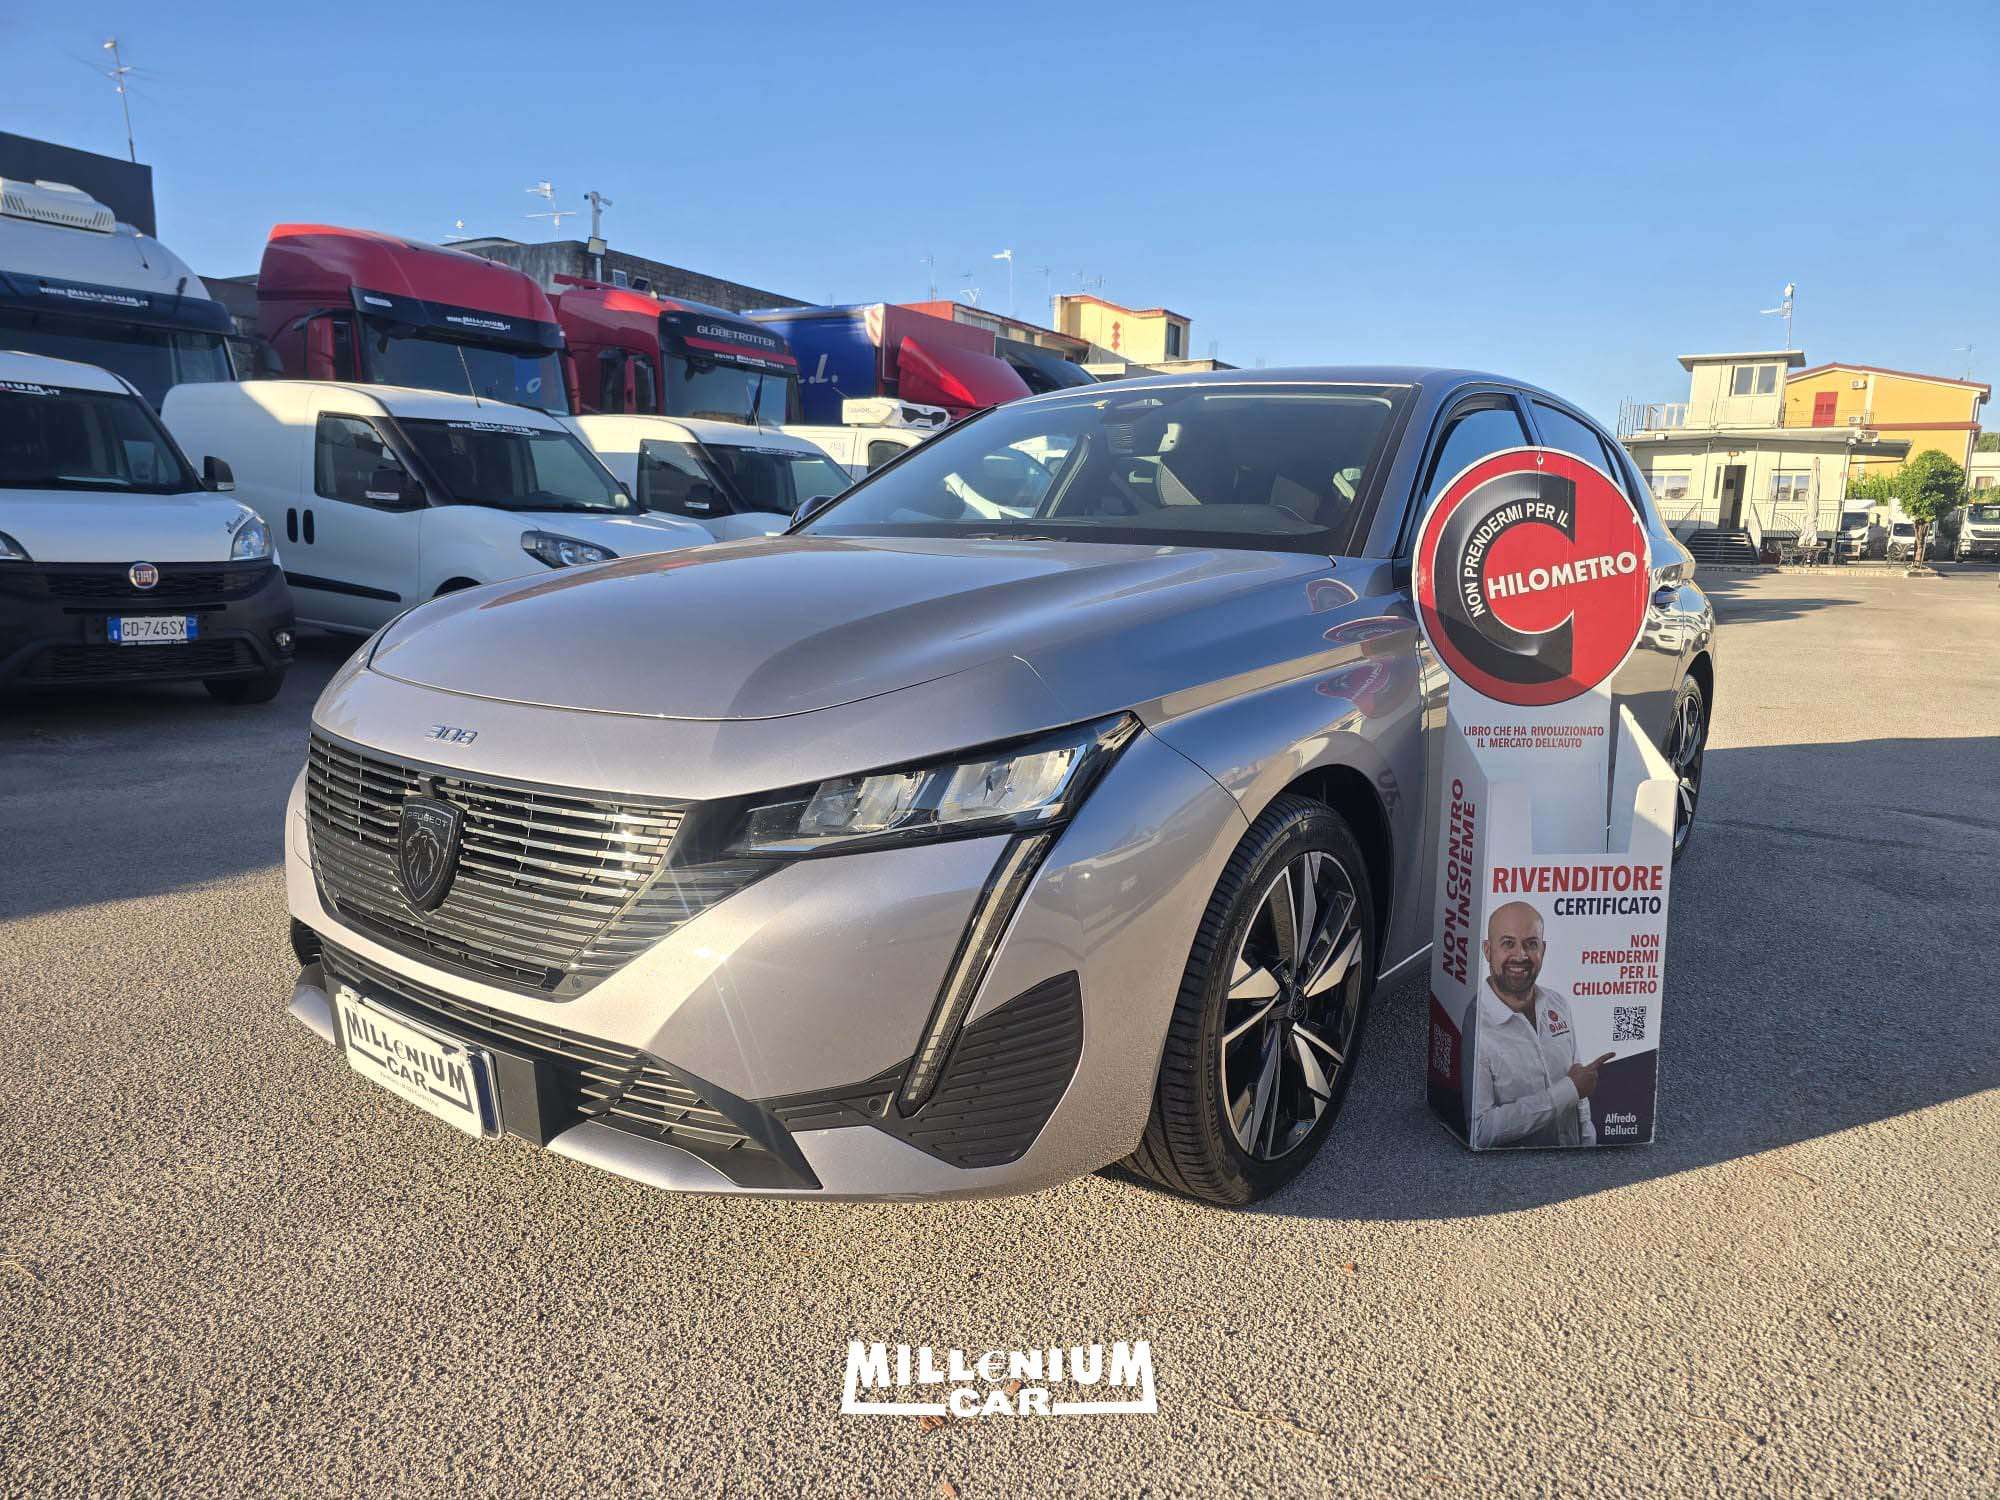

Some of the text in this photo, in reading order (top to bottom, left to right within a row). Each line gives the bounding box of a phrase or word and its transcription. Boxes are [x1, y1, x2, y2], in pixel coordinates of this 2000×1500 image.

[696, 325, 776, 348] GLOBETROTTER
[1464, 502, 1569, 618] NON PRENDERMI PER IL
[135, 570, 153, 583] FIAT
[425, 725, 478, 745] 308
[1463, 726, 1604, 736] LIBRO CHE HA RIVOLUZIONATO
[1477, 738, 1582, 748] IL MERCATO DELL'AUTO
[407, 811, 448, 827] PEUGEOT
[1442, 778, 1463, 976] NON CONTRO
[1492, 866, 1664, 893] RIVENDITORE
[1455, 801, 1475, 985] MA INSIEME
[1553, 896, 1662, 916] CERTIFICATO
[1630, 934, 1659, 948] NON
[1581, 950, 1659, 964] PRENDERMI
[1619, 965, 1659, 979] PER IL
[1572, 980, 1658, 996] CHILOMETRO
[386, 1056, 429, 1091] CAR
[1605, 1112, 1637, 1124] Alfredo
[1604, 1124, 1638, 1136] Bellucci
